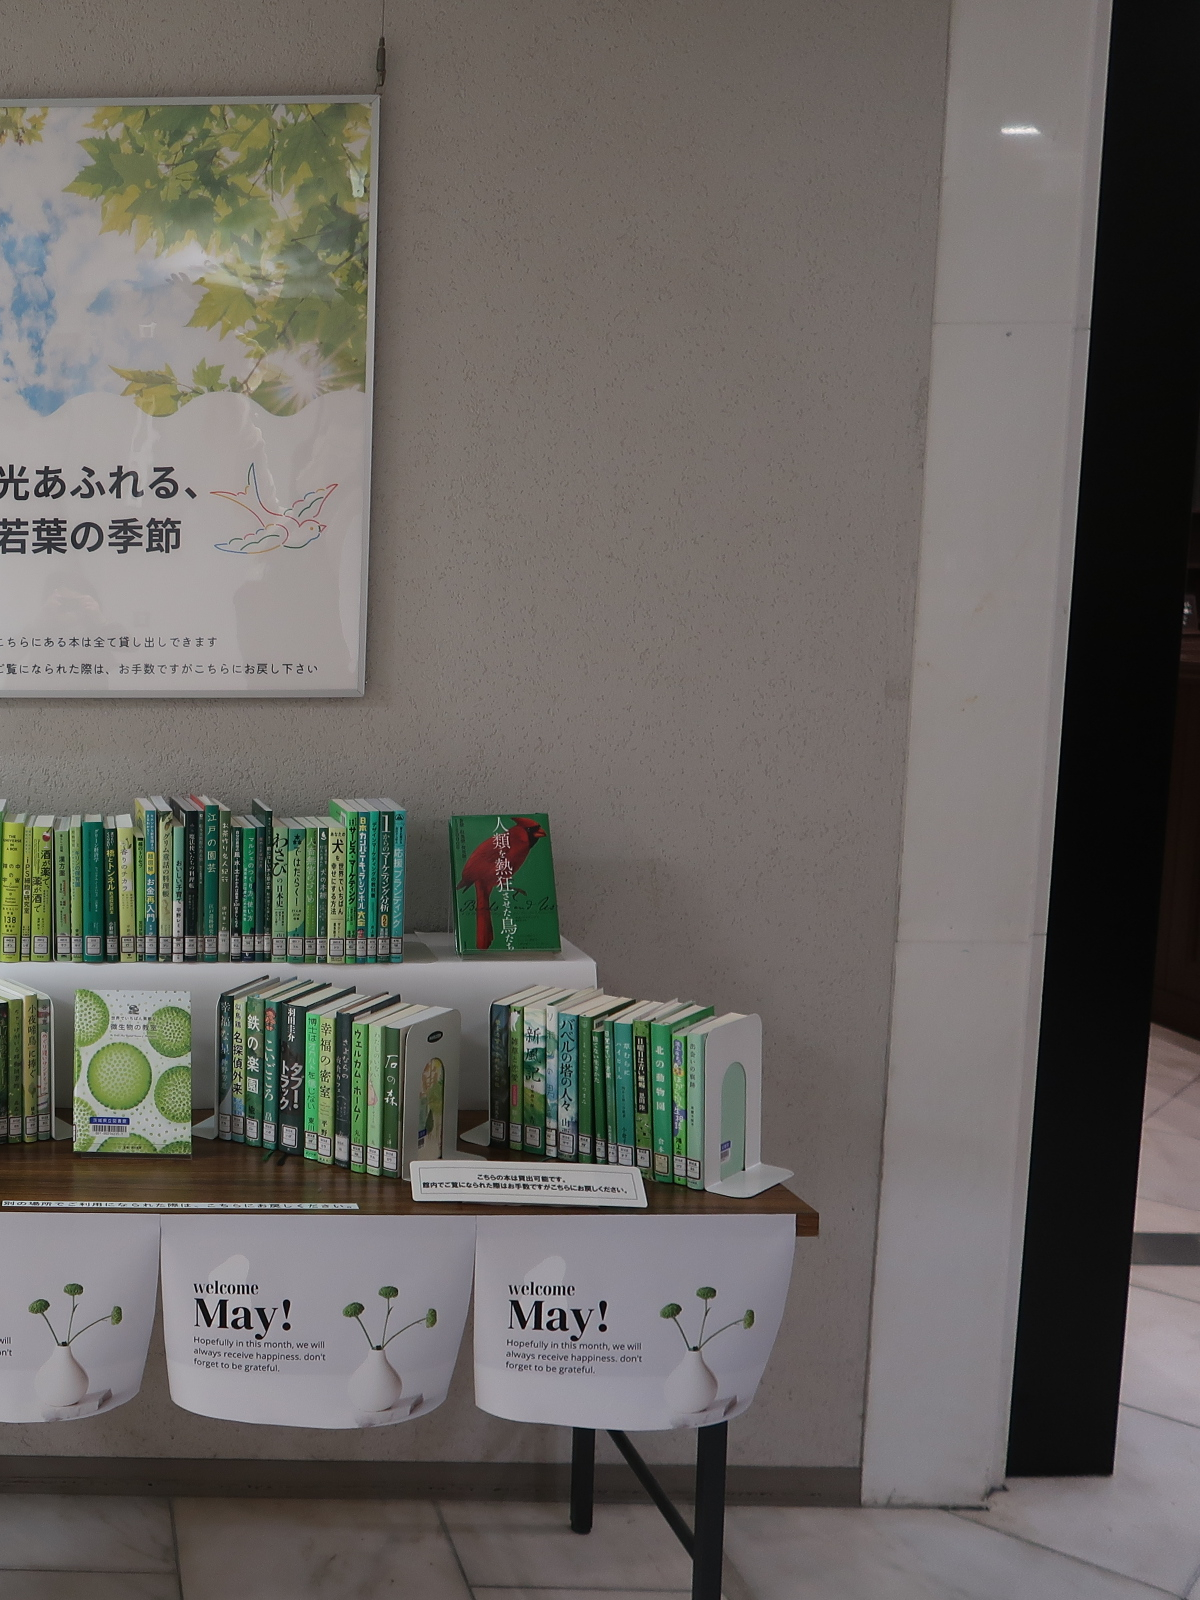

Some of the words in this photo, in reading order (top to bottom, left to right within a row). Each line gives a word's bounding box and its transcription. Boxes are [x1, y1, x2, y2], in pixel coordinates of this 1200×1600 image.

[207, 813, 217, 872] 江戸の園芸
[332, 840, 344, 854] 犬
[492, 816, 517, 950] 人類を熱狂させた鳥たち
[4, 916, 17, 924] 138
[233, 1032, 243, 1095] 名探偵外来
[246, 1014, 260, 1094] 鉄の楽園
[320, 1022, 332, 1099] 幸福の密室
[560, 1020, 575, 1112] バベルの塔の人々
[264, 1040, 275, 1101] こいごころ
[656, 1046, 666, 1111] 北の動物園
[280, 1060, 290, 1110] トラック
[477, 1174, 566, 1183] こちらの本は貸出可能です。
[194, 1281, 258, 1295] welcome
[509, 1282, 575, 1296] welcome
[194, 1298, 291, 1340] May!
[508, 1300, 607, 1341] May!
[194, 1336, 234, 1348] Hopefully
[264, 1341, 294, 1349] month,
[194, 1348, 221, 1358] always
[256, 1352, 301, 1362] happiness.
[304, 1353, 325, 1361] don't
[507, 1339, 548, 1350] Hopefully
[580, 1342, 610, 1351] month,
[627, 1342, 641, 1350] will
[194, 1358, 218, 1368] forget
[232, 1362, 242, 1370] be
[244, 1364, 280, 1372] grateful.
[506, 1350, 535, 1361] always
[571, 1354, 617, 1363] happiness.
[506, 1361, 532, 1372] forget
[559, 1366, 595, 1375] grateful.
